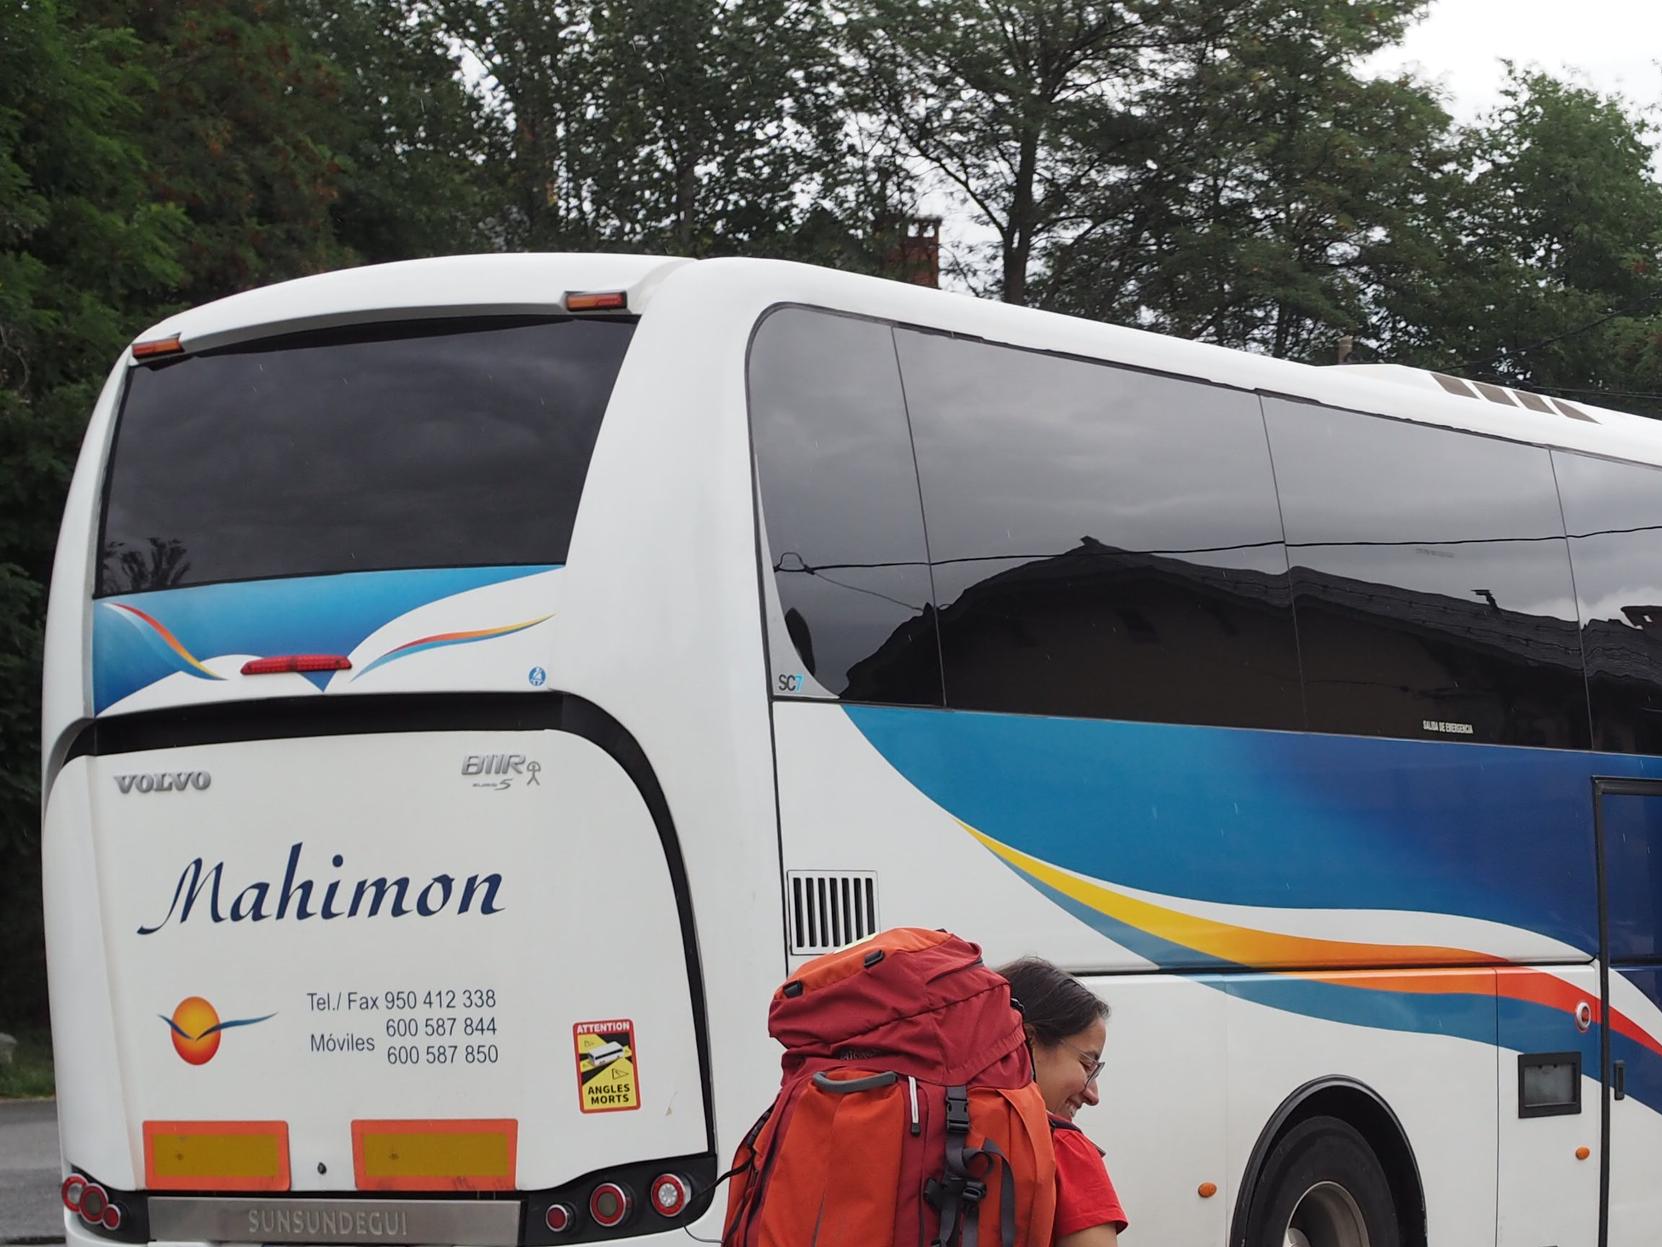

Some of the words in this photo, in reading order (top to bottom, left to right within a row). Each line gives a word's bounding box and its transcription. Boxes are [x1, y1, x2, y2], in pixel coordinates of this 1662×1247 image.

[778, 674, 804, 692] SC7
[112, 770, 212, 794] VOLVO
[136, 842, 506, 936] Mahimon
[306, 991, 342, 1011] Tel./
[347, 991, 380, 1010] Fax
[384, 990, 417, 1010] 950
[423, 989, 457, 1009] 412
[462, 988, 497, 1008] 338
[386, 1018, 419, 1037] 600
[424, 1017, 457, 1036] 587
[464, 1016, 497, 1036] 844
[576, 1021, 630, 1034] ATTENTION
[310, 1032, 376, 1052] Móviles
[387, 1046, 420, 1065] 600
[426, 1045, 458, 1064] 587
[465, 1044, 499, 1064] 850
[588, 1083, 630, 1095] ANGLES
[591, 1093, 630, 1105] MORTS
[248, 1209, 408, 1236] SUNSUNDEGUI
